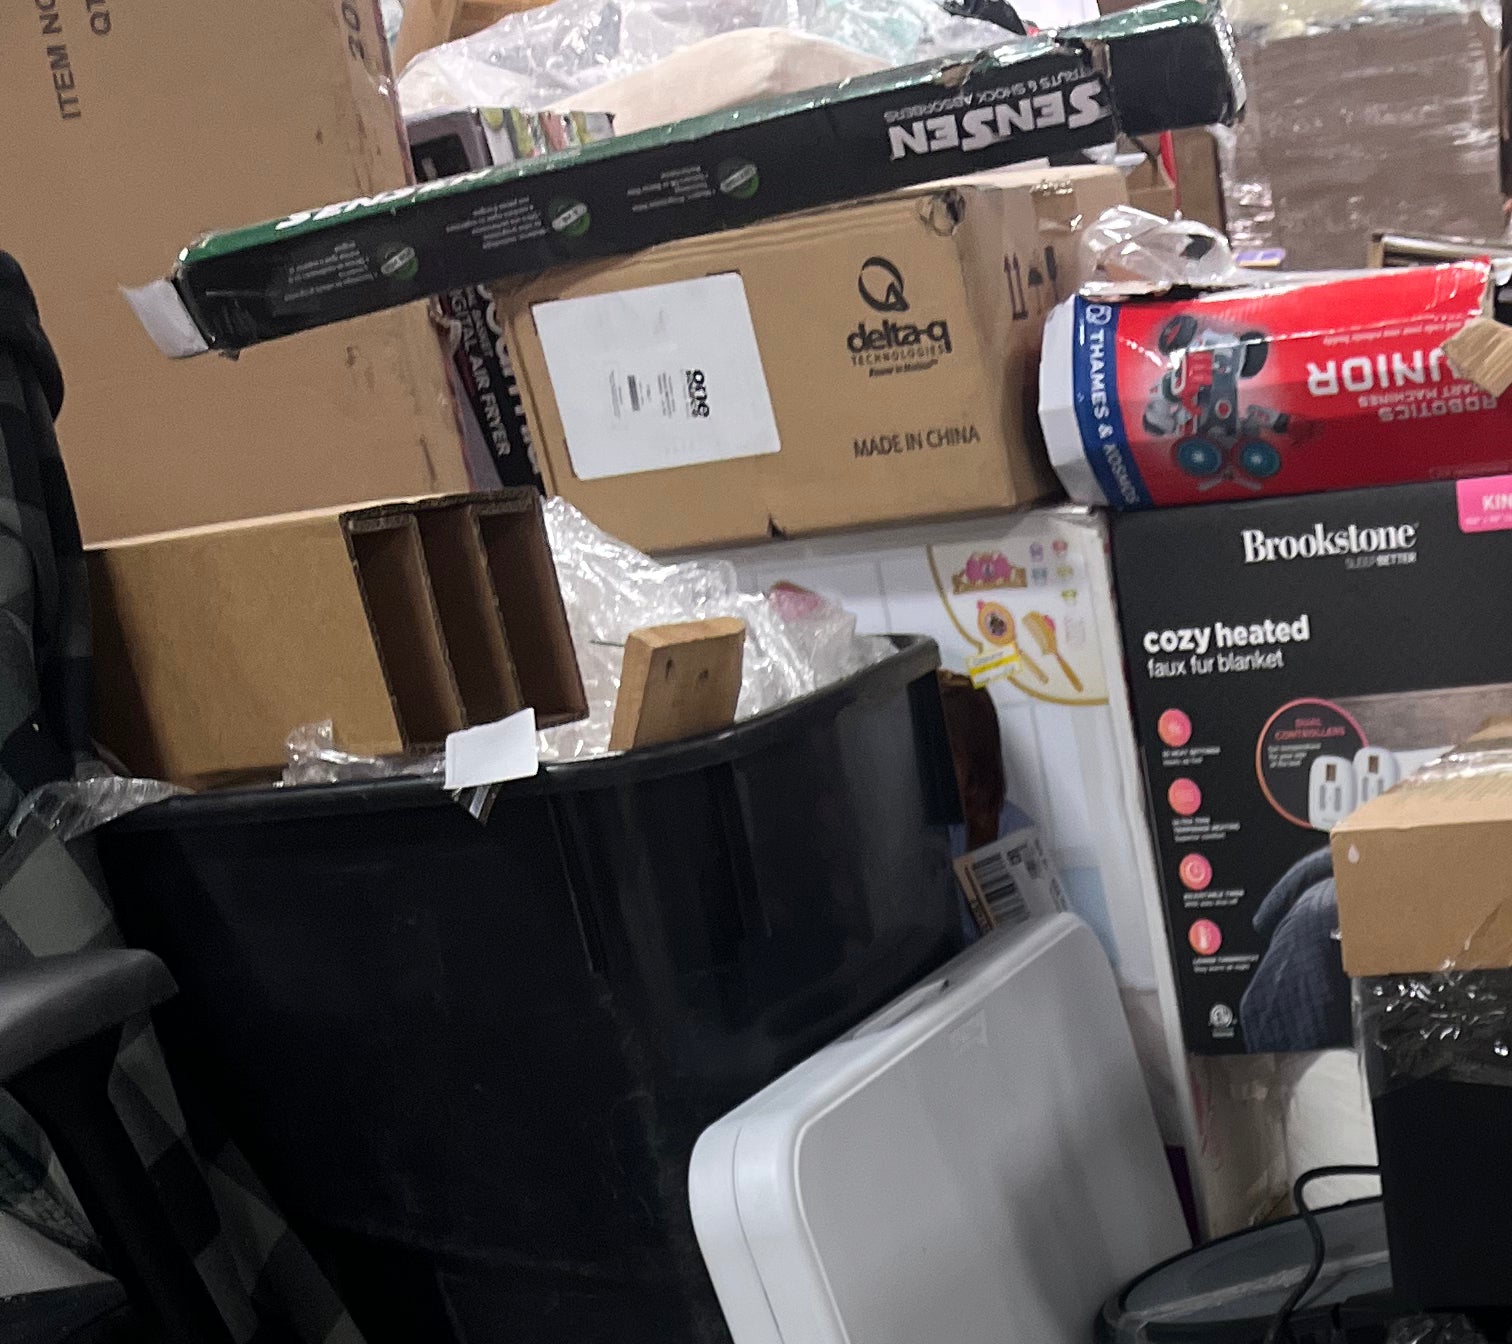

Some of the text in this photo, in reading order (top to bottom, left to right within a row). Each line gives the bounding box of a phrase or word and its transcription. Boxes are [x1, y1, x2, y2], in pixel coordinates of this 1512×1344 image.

[47, 45, 81, 119] ITEM
[1039, 67, 1092, 90] TRUTS
[888, 79, 1111, 161] SENSEN
[847, 319, 952, 354] delta-q
[1089, 328, 1110, 420] THAMES
[1306, 347, 1462, 397] UNIOR
[1441, 380, 1480, 398] ART
[469, 354, 490, 391] AIR
[480, 392, 511, 456] FRYER
[1378, 395, 1498, 422] ROBOTICS
[853, 424, 981, 458] MADE IN CHINA
[1098, 423, 1114, 439] &
[1241, 523, 1418, 564] Brookstone
[1143, 614, 1311, 654] cozy heated
[1147, 648, 1285, 679] faux fur blanket
